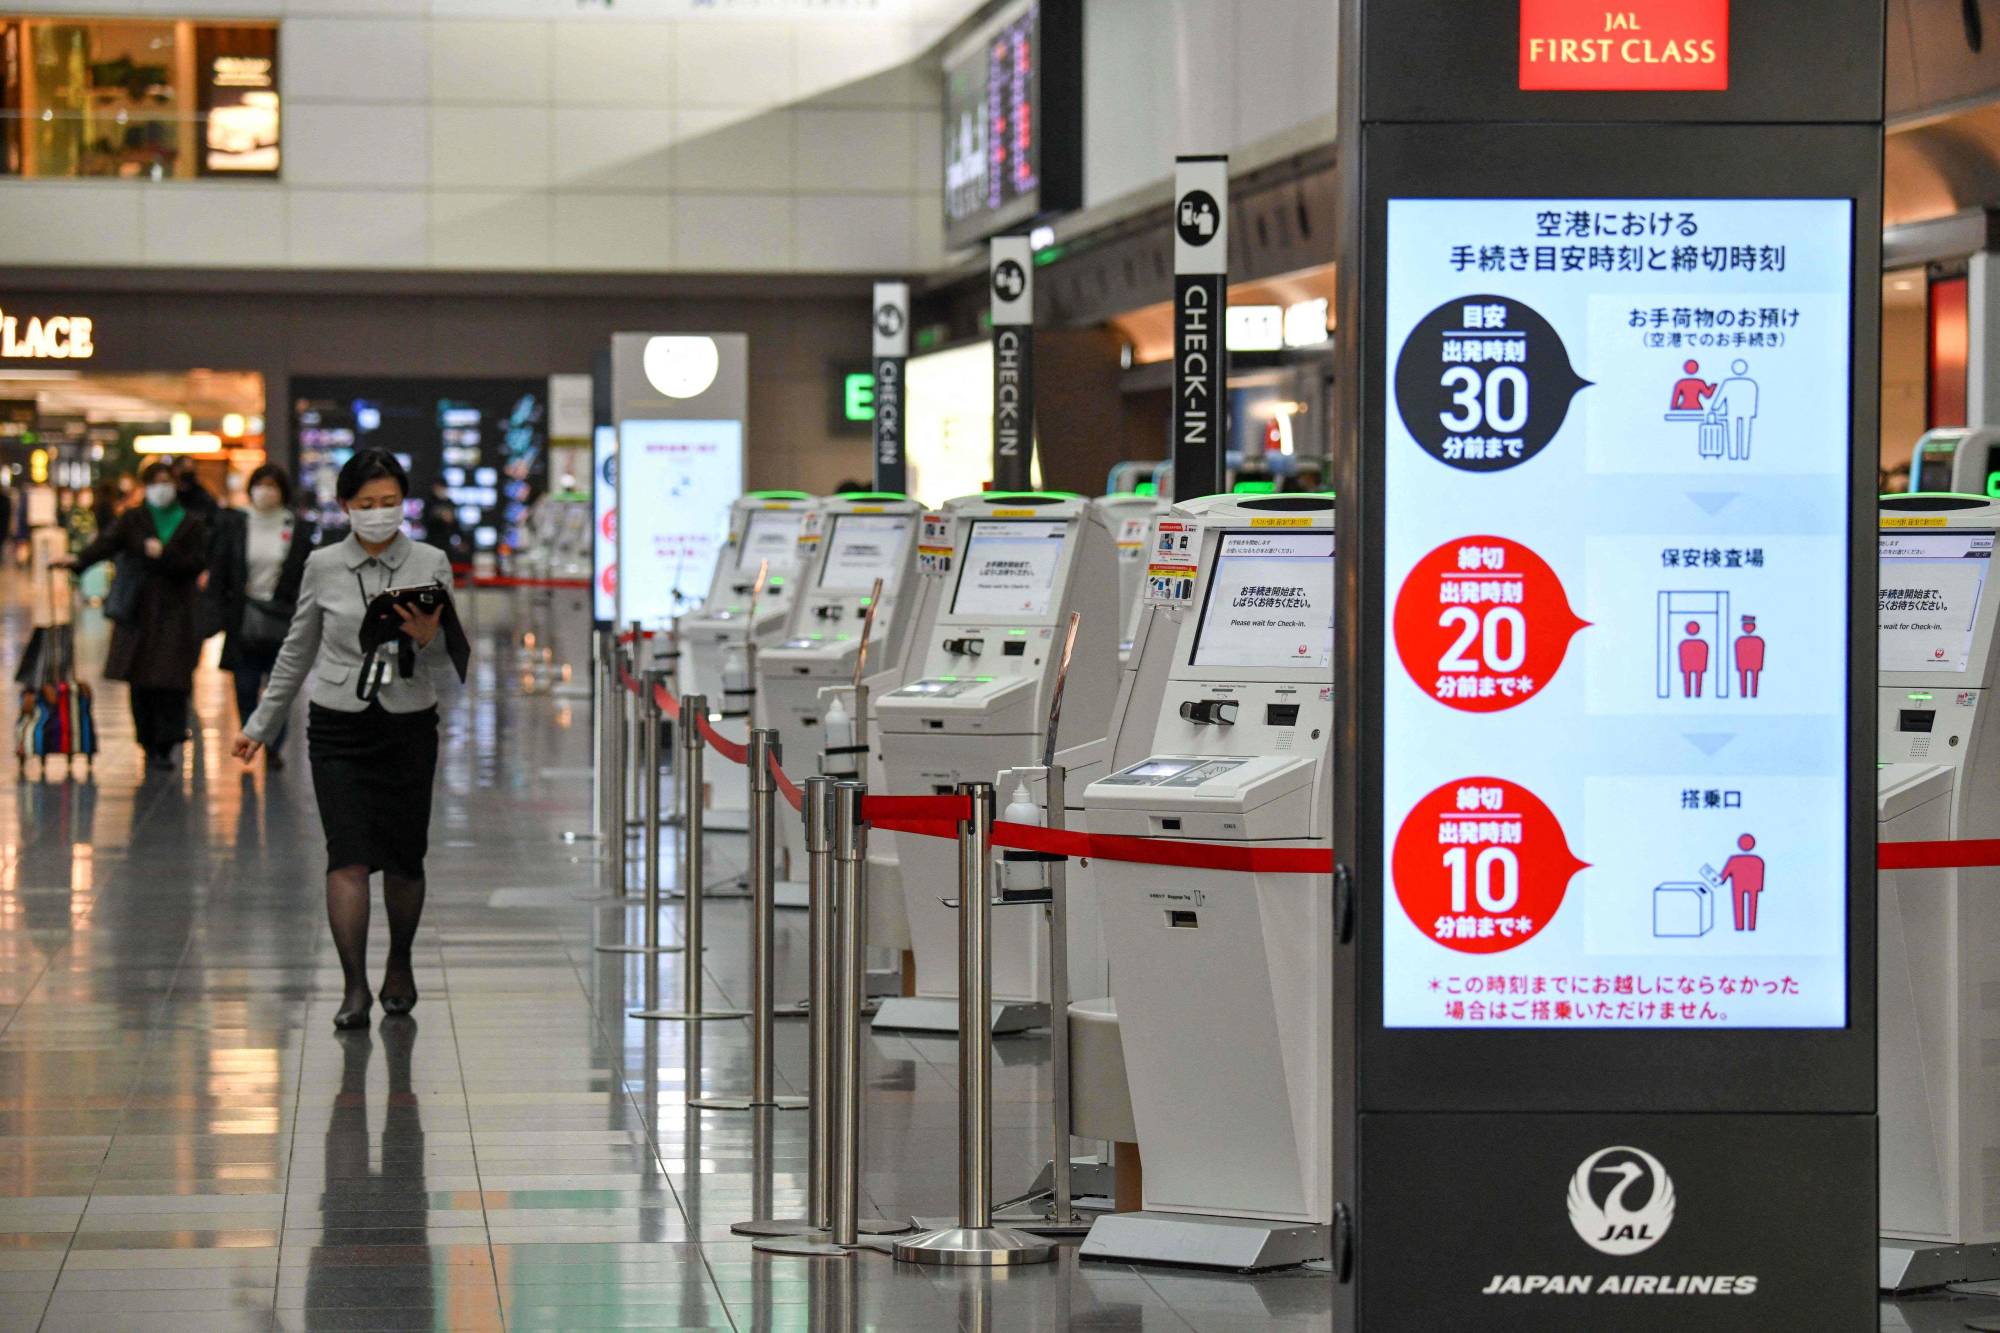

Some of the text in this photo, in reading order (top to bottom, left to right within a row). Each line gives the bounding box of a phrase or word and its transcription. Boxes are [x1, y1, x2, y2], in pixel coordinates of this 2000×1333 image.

[1605, 13, 1641, 32] JAL
[1530, 39, 1716, 64] FIRST CLASS
[1536, 211, 1697, 238] 空港における
[1450, 245, 1786, 273] 手続き目安時刻と締切時刻
[1463, 304, 1507, 329] 目安
[1629, 308, 1800, 329] お手荷物のお預け
[0, 308, 94, 358] LACE
[1442, 339, 1527, 363] 出発時刻
[1184, 285, 1208, 443] CHECK-IN
[999, 331, 1019, 456] CHECK-IN
[1440, 366, 1529, 433] 30
[879, 360, 898, 465] CHECK-IN
[1442, 436, 1524, 460] 分前まで
[1457, 545, 1505, 571] 締切
[1661, 547, 1765, 569] 保安検査場
[1232, 597, 1312, 609] しばらくお待ちください。
[1240, 586, 1307, 598] お手続き開始まで、
[1440, 581, 1524, 605] 出発時刻
[1230, 619, 1251, 627] Please
[1252, 619, 1265, 627] wait
[1266, 619, 1276, 627] for
[1438, 606, 1526, 672] 20
[1456, 786, 1504, 810] 締切
[1681, 788, 1742, 809] 搭乗口
[1438, 820, 1522, 845] 出発時刻
[1443, 846, 1519, 913] 10
[1445, 1000, 1728, 1021] 場合はご搭乗いただけません。
[1598, 1224, 1654, 1241] JAL
[1482, 1275, 1759, 1295] JAPAN AIRLINES
